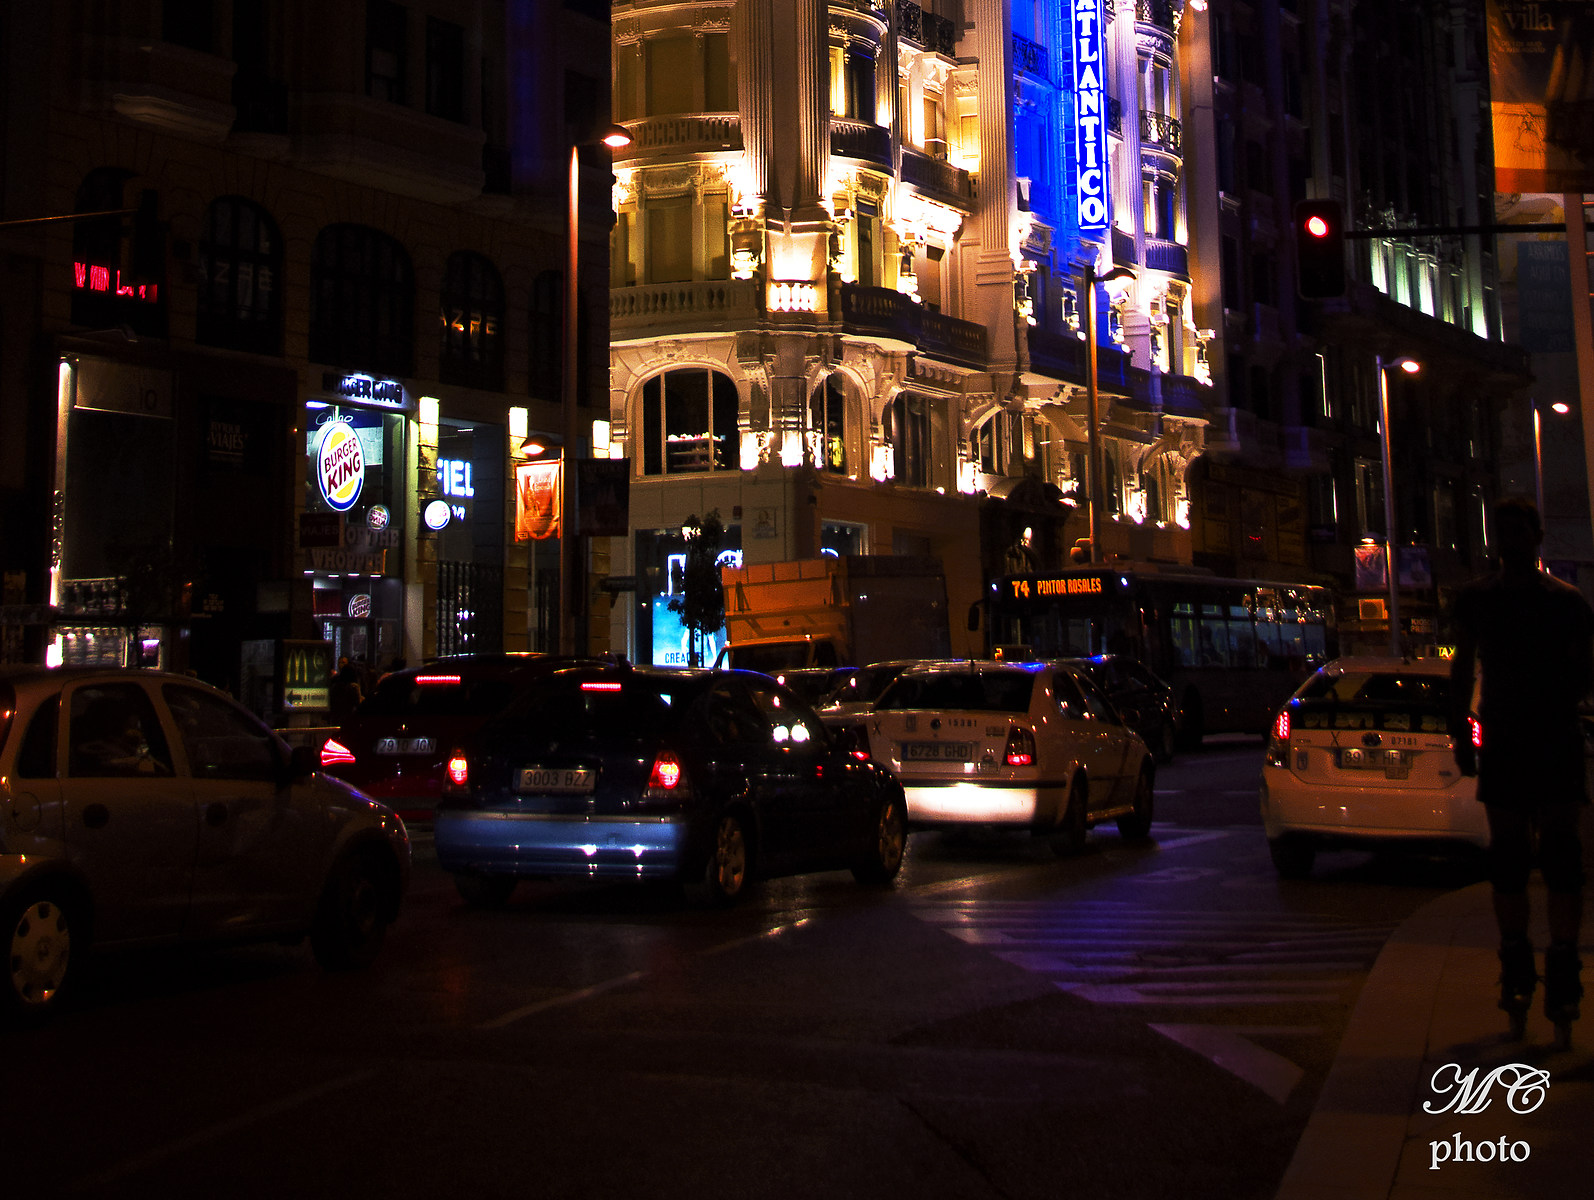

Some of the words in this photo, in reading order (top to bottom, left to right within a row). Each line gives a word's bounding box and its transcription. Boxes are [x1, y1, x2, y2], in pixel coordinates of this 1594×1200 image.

[1504, 3, 1555, 31] villa
[324, 437, 358, 473] BURGER
[327, 452, 361, 495] KING
[1012, 580, 1031, 599] 74
[1037, 579, 1067, 595] PINTOR
[1067, 577, 1102, 594] ROSALES
[1438, 646, 1456, 658] TAX
[910, 743, 939, 757] 6728
[525, 771, 559, 786] 3003
[565, 771, 591, 787] BZZ
